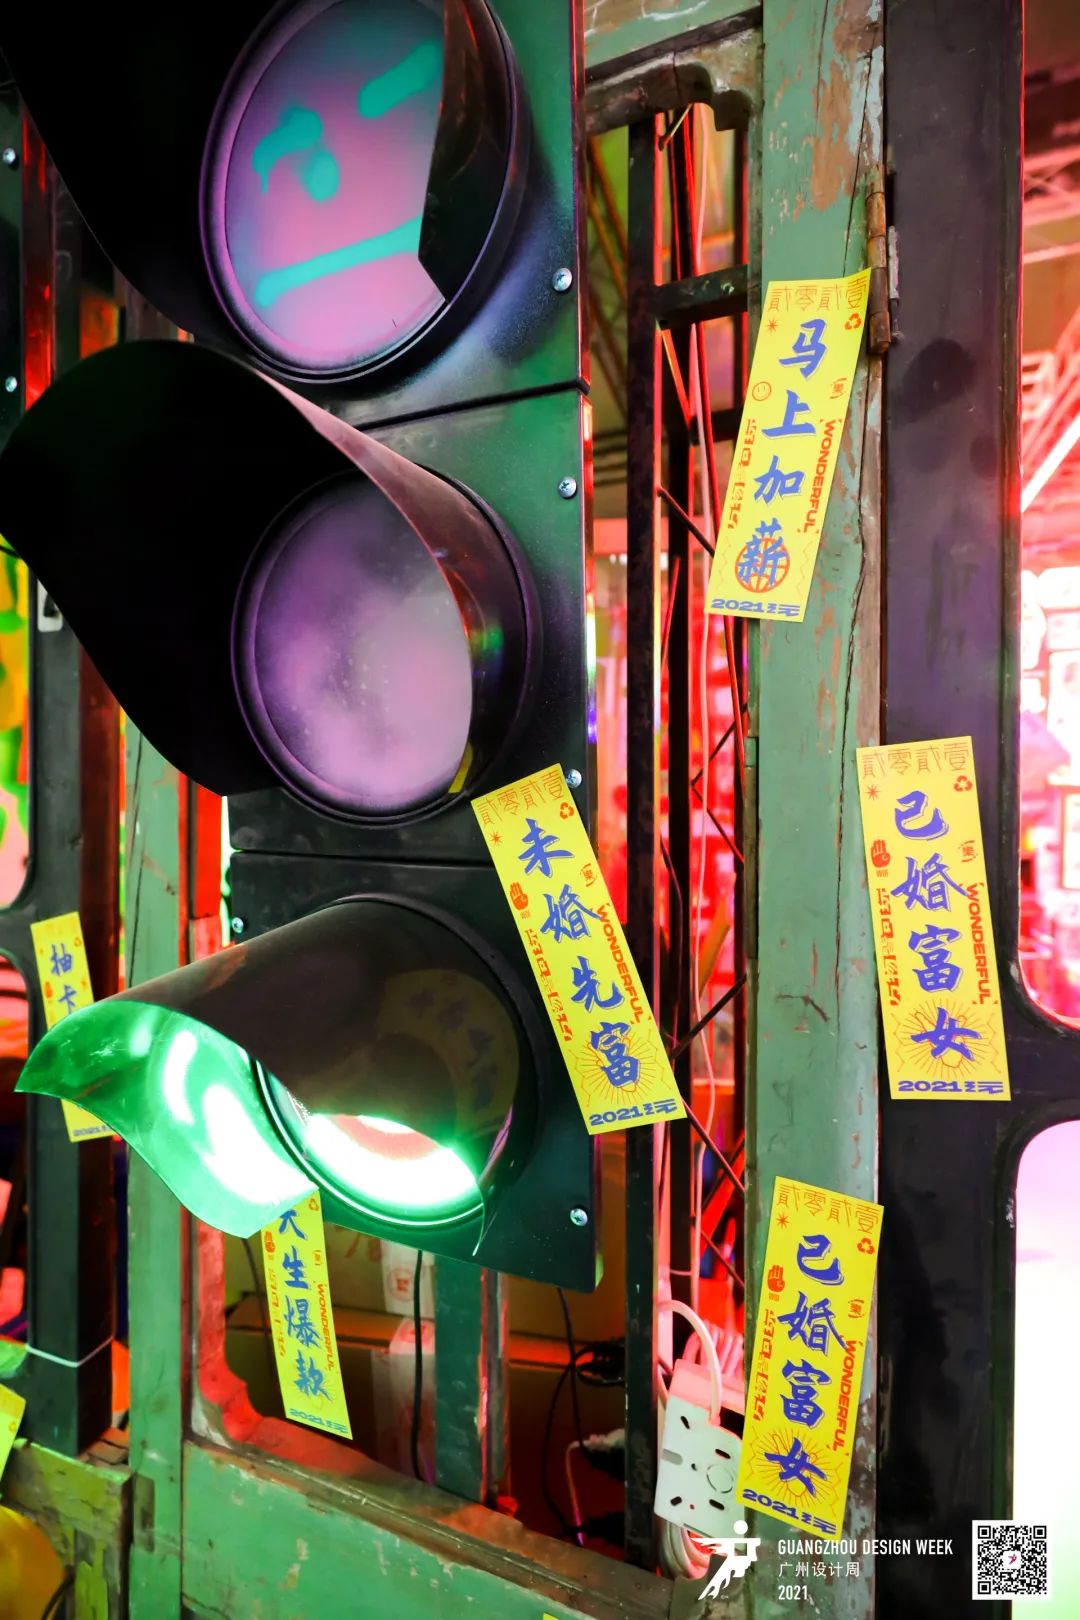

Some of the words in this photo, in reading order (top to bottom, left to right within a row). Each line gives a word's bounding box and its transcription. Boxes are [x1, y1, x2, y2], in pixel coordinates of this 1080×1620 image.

[737, 318, 828, 588] 马上加薪
[803, 420, 836, 533] WONDERFUL
[518, 818, 641, 1089] 未婚先富
[597, 905, 642, 1024] WONDERFUL
[890, 790, 983, 1061] 已婚富女
[965, 884, 992, 1005] WONDERFUL
[764, 1234, 850, 1498] 已婚富女
[833, 1340, 857, 1452] WONDERFUL
